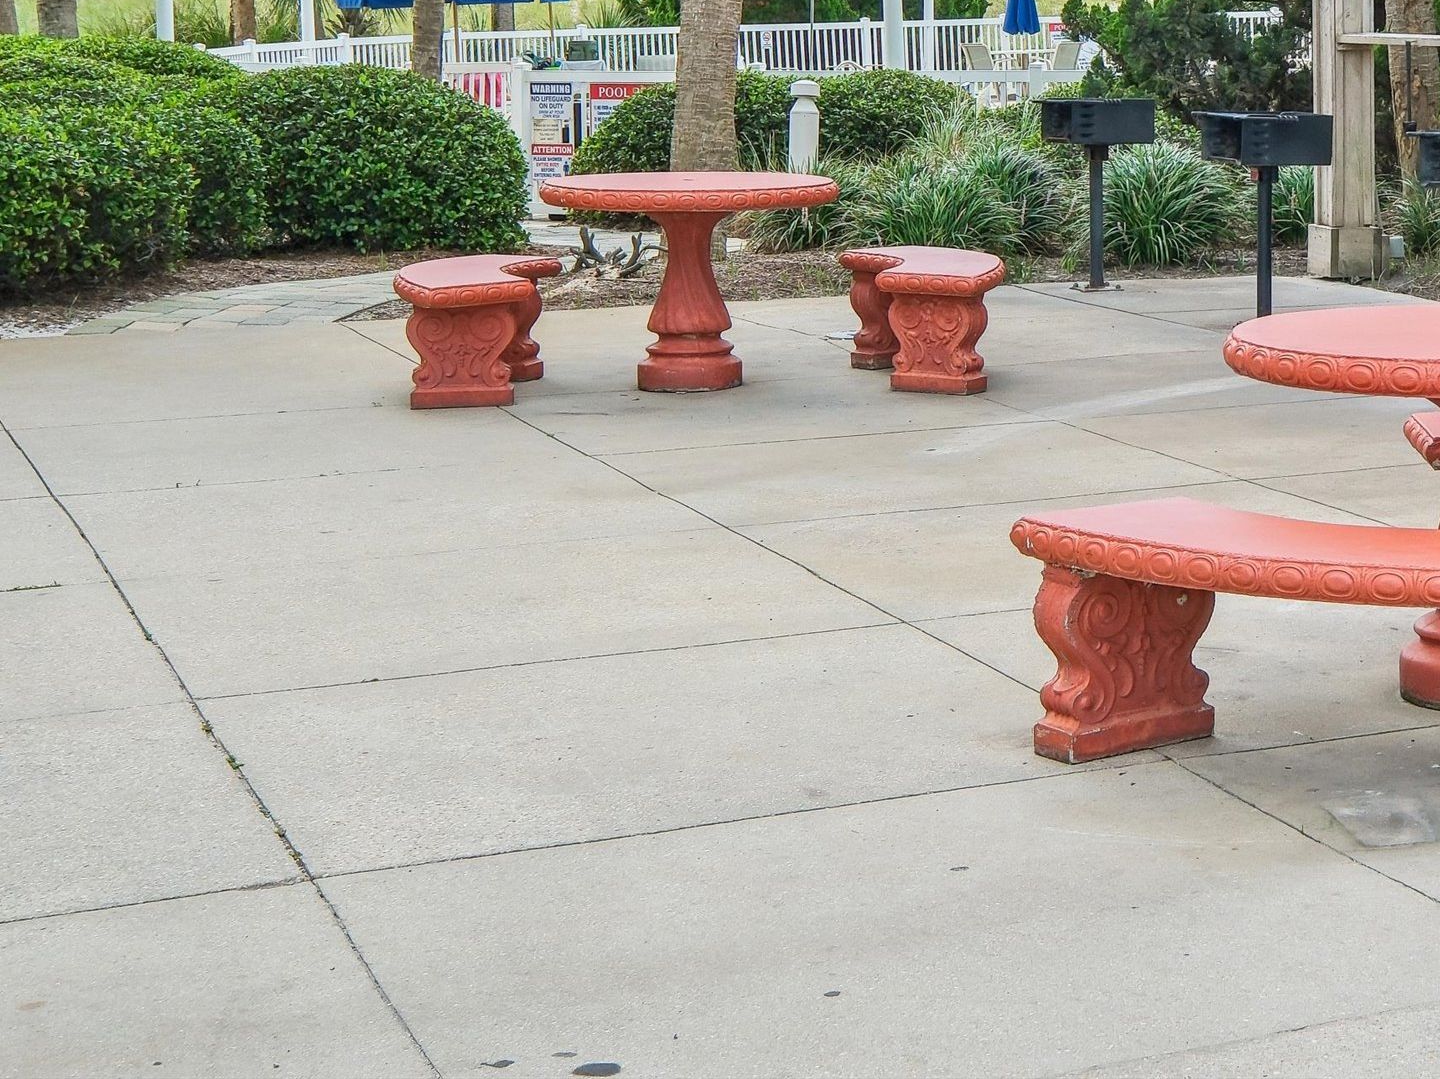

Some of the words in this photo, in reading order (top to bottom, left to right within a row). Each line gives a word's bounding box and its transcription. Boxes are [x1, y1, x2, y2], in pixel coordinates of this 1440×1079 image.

[531, 84, 571, 94] WARNING
[599, 87, 630, 98] POOL
[533, 146, 572, 154] ATTENTION
